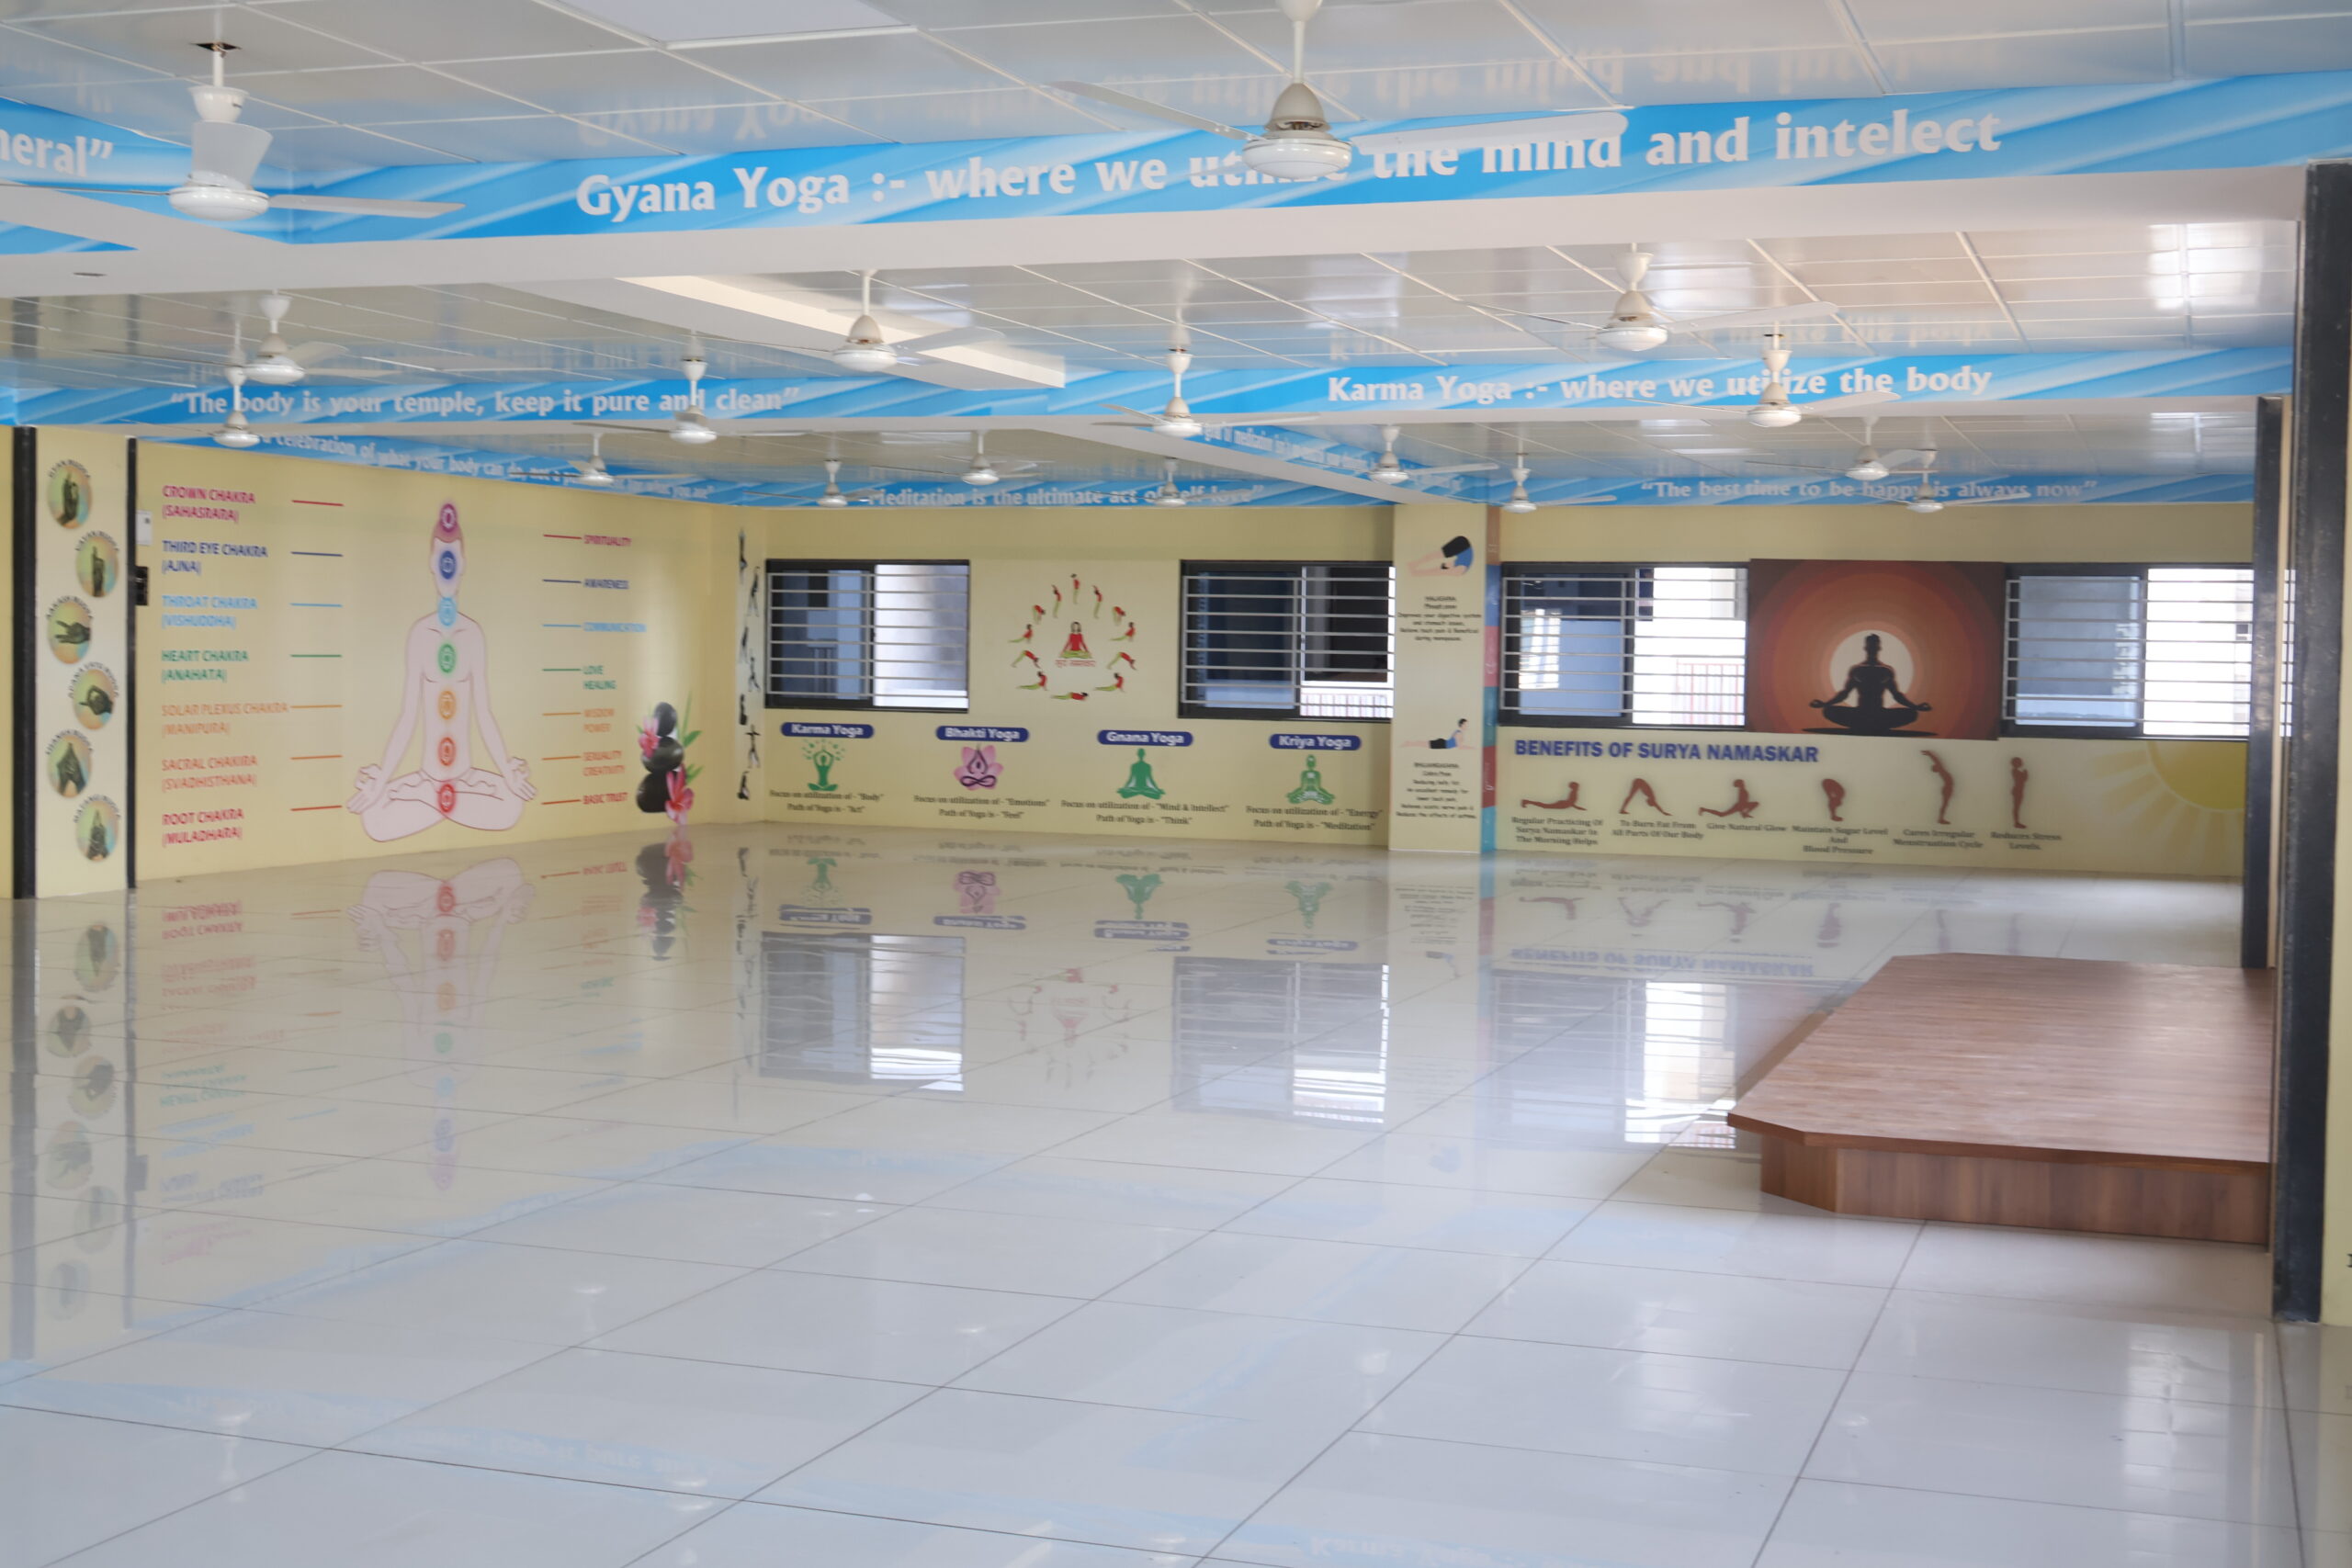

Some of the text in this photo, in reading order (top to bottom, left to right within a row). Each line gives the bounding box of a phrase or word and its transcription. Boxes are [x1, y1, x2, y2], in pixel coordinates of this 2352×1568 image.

[576, 175, 716, 222] Gyana
[733, 166, 850, 214] Yoga
[925, 157, 1076, 199] where
[1094, 157, 1168, 192] we
[1645, 117, 1749, 164] and
[1774, 108, 2002, 160] intelect
[1328, 377, 1424, 401] Karma
[1436, 376, 1512, 404] Yoga
[1560, 374, 1657, 399] where
[1668, 377, 1715, 397] we
[1839, 367, 1894, 393] the
[1906, 366, 1993, 395] body
[238, 390, 294, 415] body
[302, 389, 321, 412] is
[329, 393, 382, 416] your
[393, 391, 484, 416] temple,
[494, 390, 555, 416] keep
[563, 389, 582, 412] it
[593, 393, 650, 416] pure
[659, 389, 706, 412] and
[162, 484, 256, 504] CROWN CHAKRA
[971, 488, 987, 505] is
[993, 488, 1023, 505] the
[1025, 486, 1102, 505] ultimate
[1109, 489, 1139, 504] act
[1699, 480, 1742, 497] best
[1745, 479, 1792, 496] time
[1798, 482, 1821, 497] to
[1828, 480, 1854, 497] be
[1933, 480, 1950, 497] is
[162, 539, 269, 558] THIRD EYE CHAKRA
[161, 649, 250, 662] HEART CHAKRA
[792, 723, 864, 739] Karma Yoga
[944, 727, 1021, 742] Bhakti Yoga
[1105, 731, 1185, 746] Gnana Yoga
[1278, 735, 1352, 750] Kriya Yoga
[1514, 739, 1820, 763] BENEFITS OF SURYA NAMASKAR
[161, 807, 245, 826] ROOT CHAKRA
